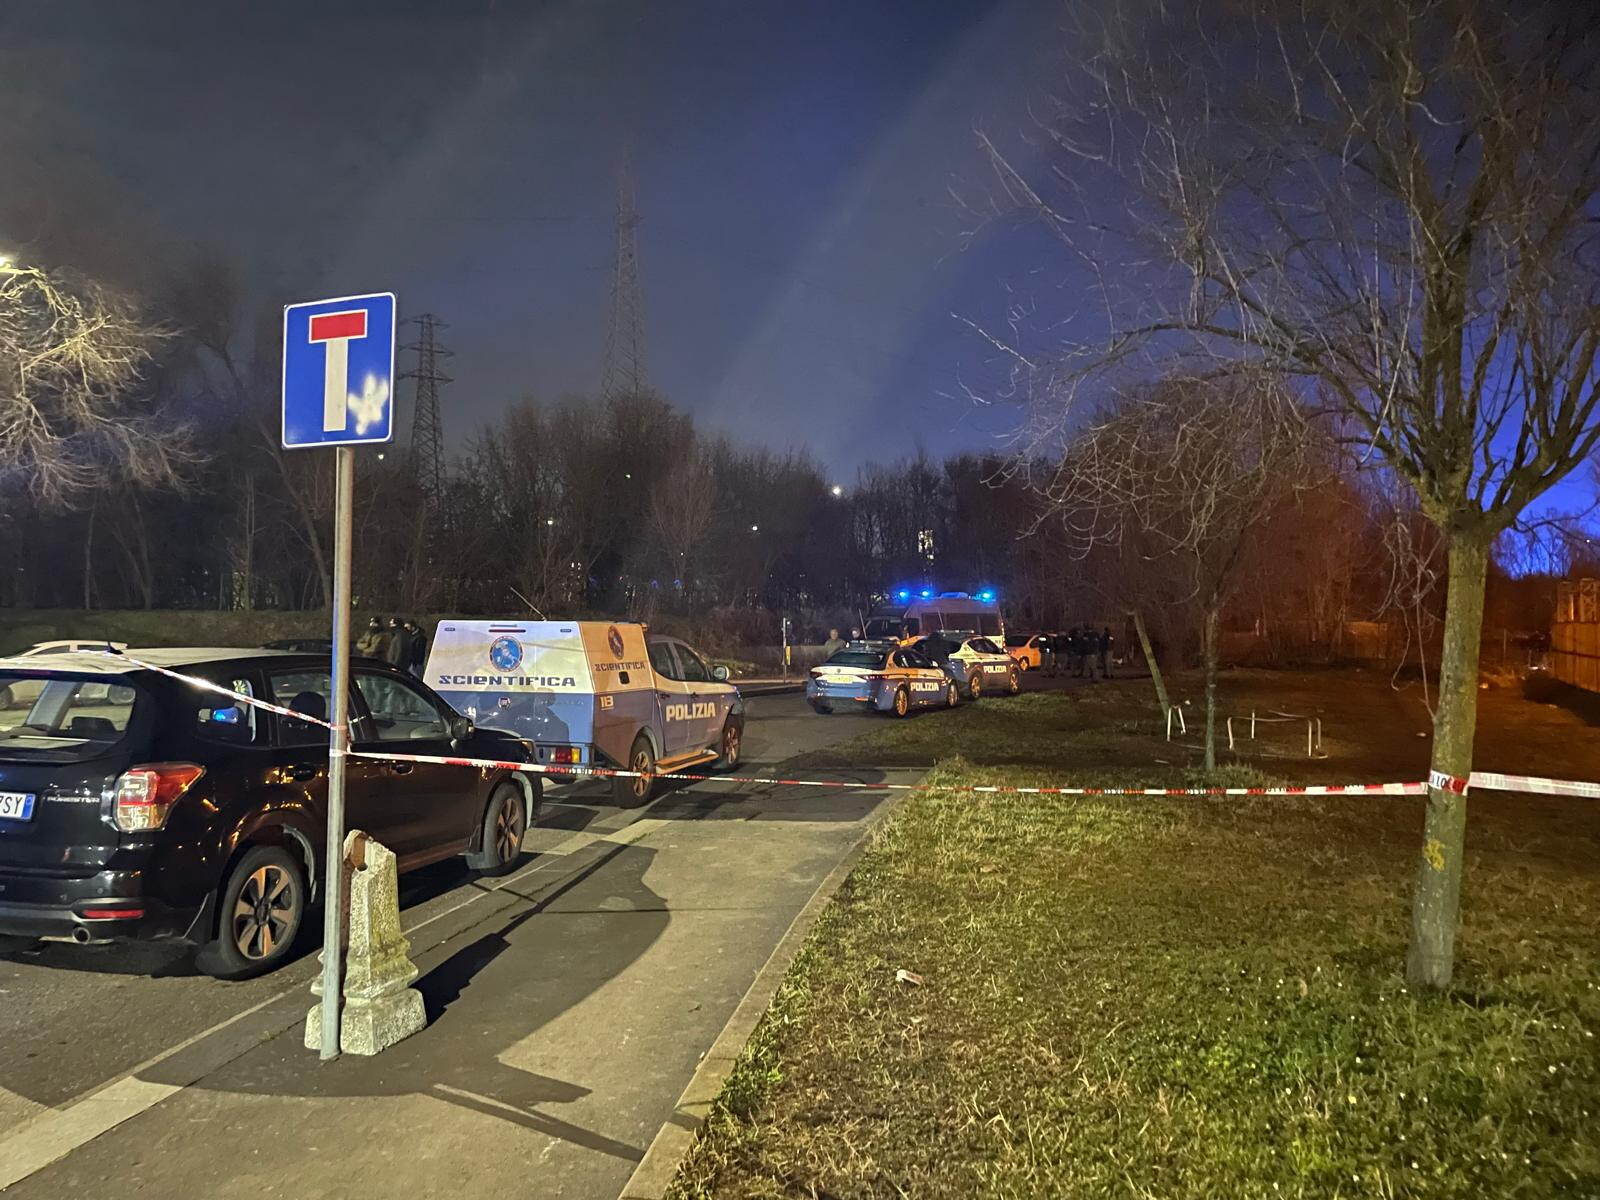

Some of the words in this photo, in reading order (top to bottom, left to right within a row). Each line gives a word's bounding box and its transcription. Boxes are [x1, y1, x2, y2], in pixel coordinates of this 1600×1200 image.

[983, 665, 1007, 673] POLIZIA
[910, 682, 939, 692] POLIZIA
[666, 702, 716, 721] POLIZIA
